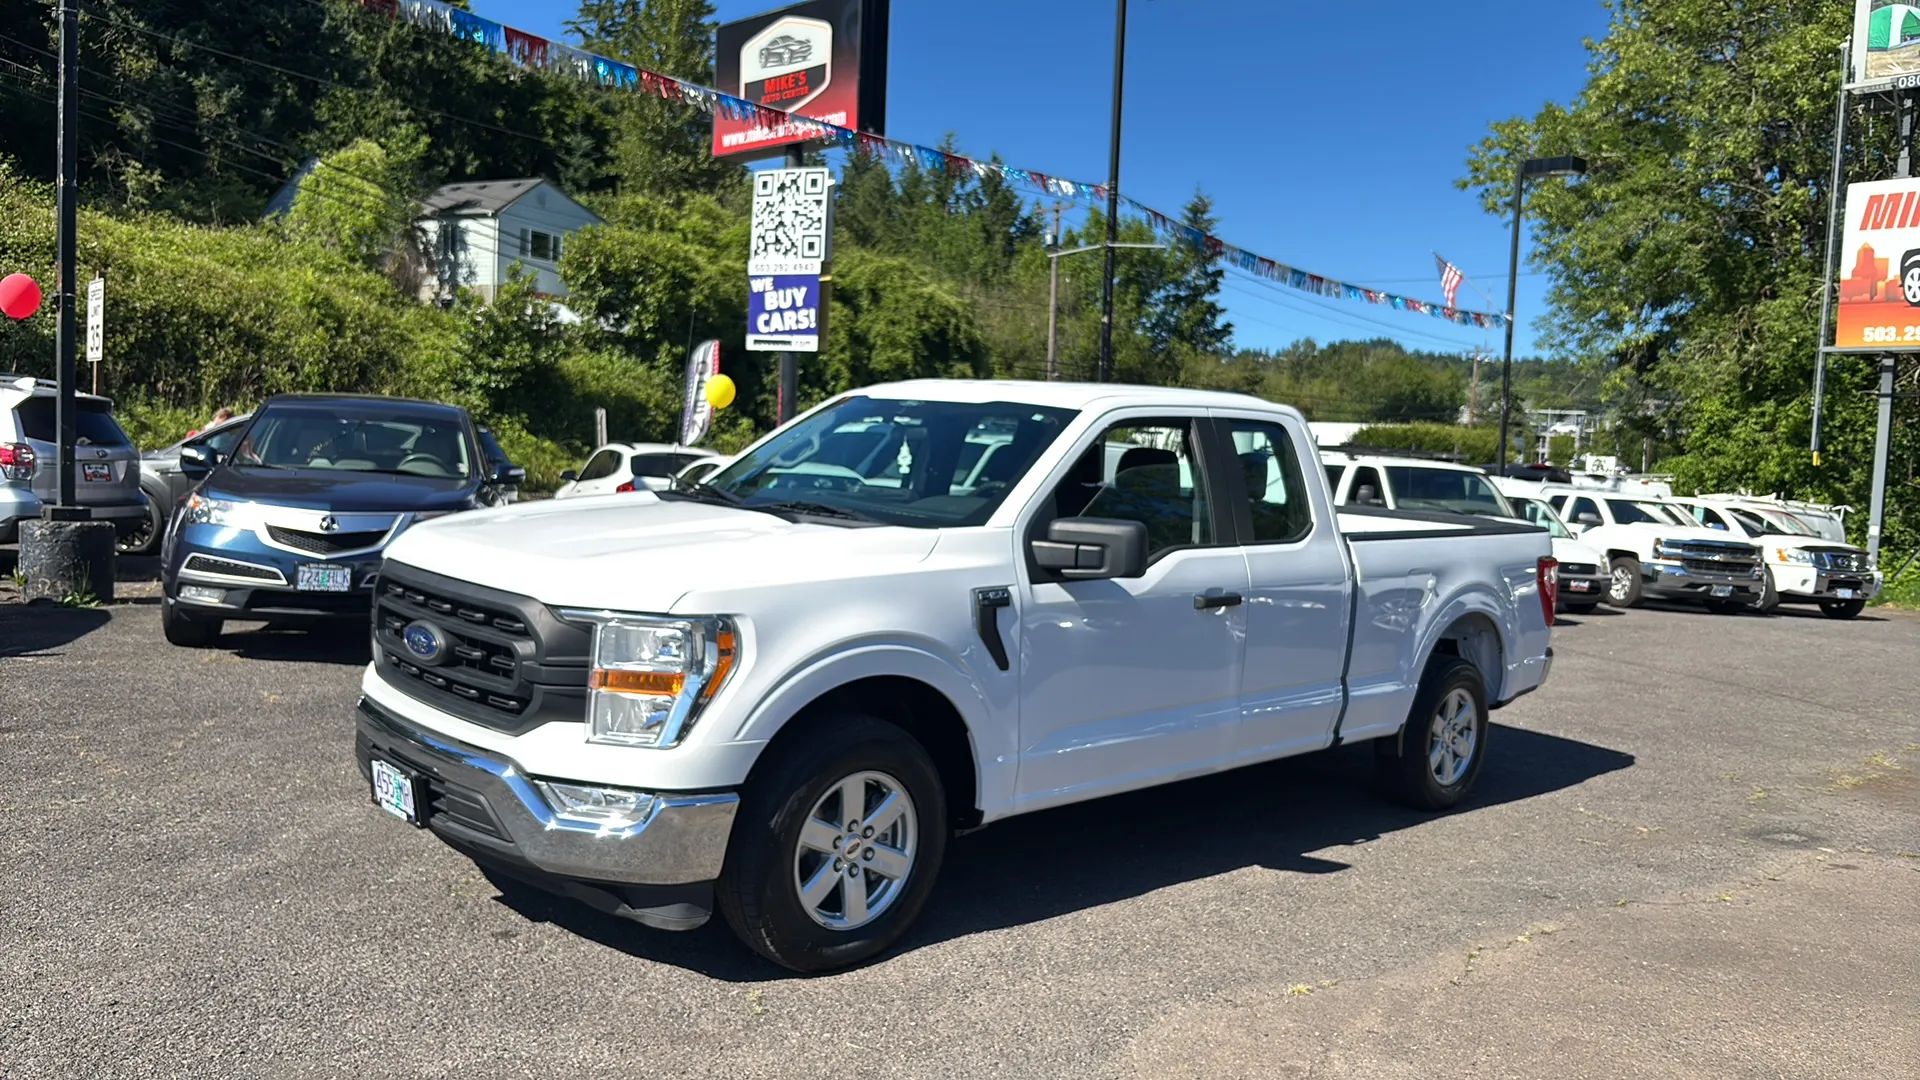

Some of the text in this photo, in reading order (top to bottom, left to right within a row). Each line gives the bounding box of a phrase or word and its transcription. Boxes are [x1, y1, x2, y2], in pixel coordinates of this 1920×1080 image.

[764, 71, 808, 93] MIKE'S
[761, 86, 810, 105] AUTO CENTER
[1859, 191, 1920, 231] MI
[750, 276, 775, 293] WE
[763, 286, 808, 312] BUY
[756, 307, 817, 335] CARS!
[90, 324, 101, 352] 35
